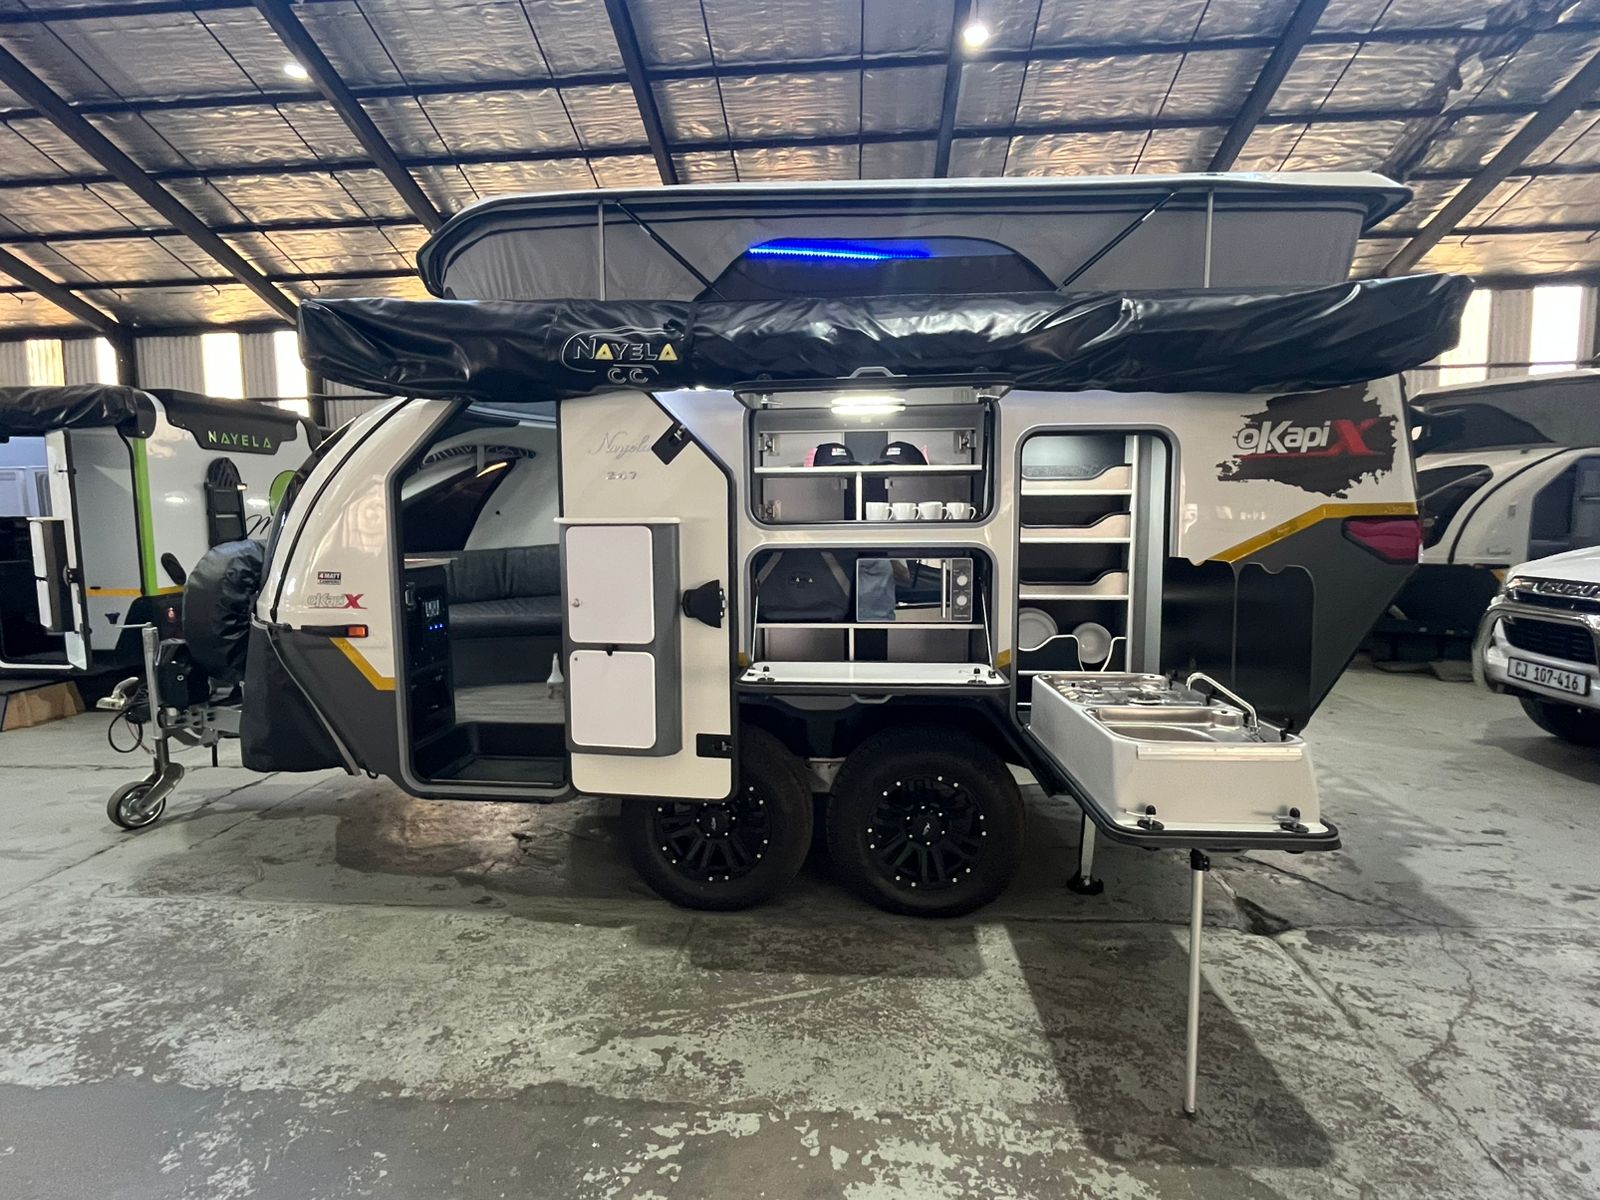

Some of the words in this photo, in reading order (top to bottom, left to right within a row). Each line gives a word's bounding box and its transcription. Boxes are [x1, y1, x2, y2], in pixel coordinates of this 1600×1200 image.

[573, 338, 678, 361] NAYELA
[207, 430, 272, 449] NAYELA
[1540, 581, 1599, 596] ISUZU
[1515, 662, 1528, 677] CJ
[1533, 666, 1579, 691] 107-416
